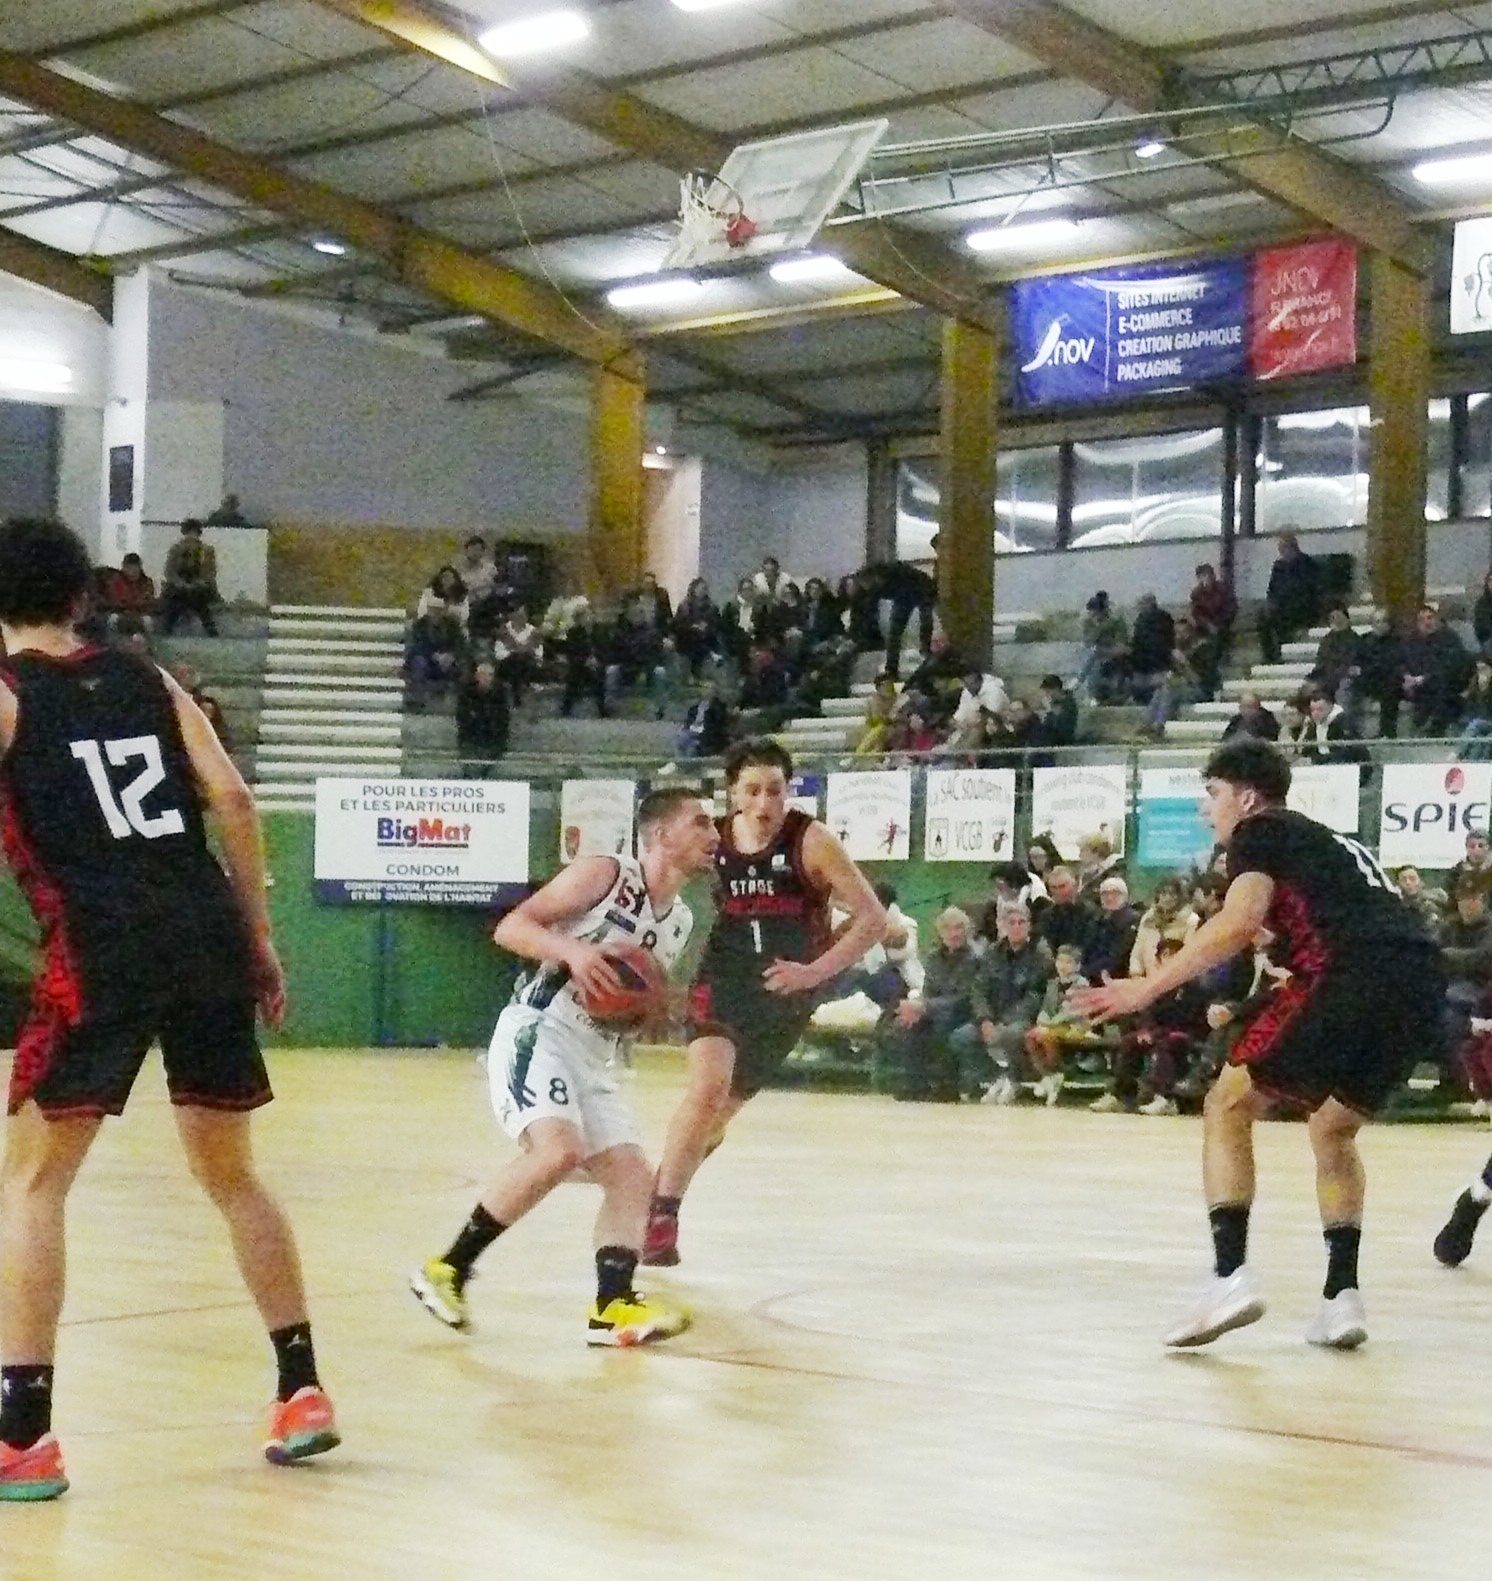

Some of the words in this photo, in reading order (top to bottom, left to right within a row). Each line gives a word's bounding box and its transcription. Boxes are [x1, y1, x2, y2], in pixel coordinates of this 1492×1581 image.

[1118, 307, 1194, 334] E-COMMERCE
[1117, 333, 1173, 358] CREATION
[1174, 325, 1242, 351] GRAPHIQUE
[1117, 357, 1183, 382] PACKAGING
[69, 734, 186, 840] 12
[362, 785, 406, 797] POUR
[410, 786, 438, 798] LES
[442, 786, 485, 799] PROS
[340, 799, 359, 811] ET
[363, 800, 391, 811] LES
[395, 800, 507, 814] PARTICULIERS
[1382, 802, 1488, 833] SPIE
[376, 817, 472, 847] BigMat
[386, 863, 460, 876] CONDOM
[750, 919, 762, 954] 1
[548, 1076, 570, 1106] 8
